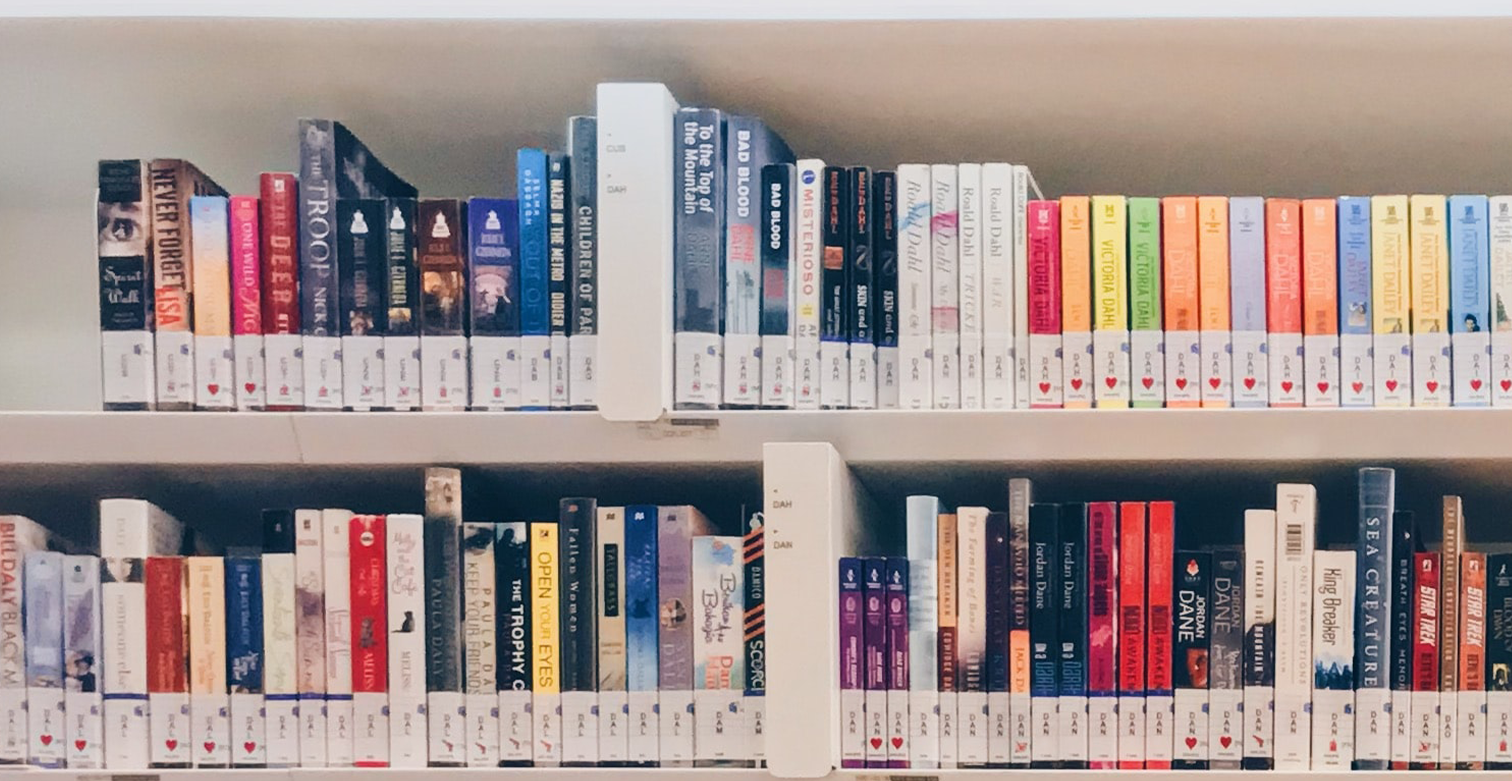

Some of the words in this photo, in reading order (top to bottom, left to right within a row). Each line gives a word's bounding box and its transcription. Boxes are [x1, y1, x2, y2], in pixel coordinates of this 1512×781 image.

[684, 122, 698, 146] the
[700, 125, 714, 140] To
[738, 131, 750, 162] BAD
[700, 143, 714, 167] the
[153, 169, 175, 222] NEVER
[684, 149, 698, 214] Mountain
[697, 171, 713, 195] Top
[738, 167, 750, 217] BLOOD
[770, 183, 780, 207] BAD
[700, 198, 714, 212] of
[964, 188, 974, 222] Roald
[990, 188, 1002, 222] Roald
[307, 180, 330, 278] TROOP
[551, 227, 564, 244] THE
[578, 206, 592, 278] CHILDREN
[770, 211, 780, 249] BLOOD
[803, 189, 814, 295] MISTERIOSO
[964, 226, 974, 256] Dahl
[990, 226, 1002, 256] Dahl
[157, 229, 186, 290] FORGET
[552, 248, 564, 281] METRO
[908, 232, 923, 272] Dahl
[936, 232, 951, 272] Dahl
[1102, 240, 1114, 293] VICTORIA
[1383, 232, 1396, 268] JANET
[1420, 232, 1434, 268] JANET
[1136, 243, 1150, 296] VICTORIA
[1274, 253, 1288, 299] DAHL
[156, 287, 180, 325] LISA
[552, 292, 564, 326] DIDIER
[579, 284, 592, 301] OF
[857, 285, 867, 306] SKIN
[884, 290, 894, 312] SKIN
[1384, 272, 1397, 314] DAILEY
[1421, 271, 1434, 314] DAILEY
[1102, 299, 1115, 328] DAHL
[1137, 300, 1151, 329] DAHL
[773, 500, 792, 509] DAH
[0, 523, 15, 558] BILL
[568, 528, 580, 574] Fallen
[774, 540, 792, 549] DAN
[1366, 518, 1379, 556] SEA
[538, 552, 552, 598] OPEN
[966, 534, 978, 584] Farming
[1035, 542, 1047, 578] Jordan
[1062, 542, 1074, 578] Jordan
[0, 559, 16, 604] DALY
[466, 562, 479, 595] KEEP
[512, 580, 522, 600] THE
[751, 566, 762, 599] DAMICO
[1036, 582, 1047, 609] Dane
[1063, 581, 1074, 608] Dane
[1318, 568, 1342, 594] King
[1400, 560, 1408, 604] BREATH
[431, 578, 443, 630] PAULA
[467, 600, 480, 637] YOUR
[482, 588, 492, 649] PAULA
[569, 581, 580, 632] Women
[1178, 590, 1194, 642] DANE
[1196, 595, 1205, 638] JORDAN
[1214, 578, 1230, 634] DANE
[1232, 584, 1240, 628] JORDAN
[1420, 586, 1436, 616] STAR
[1466, 586, 1482, 616] STAR
[2, 612, 18, 663] BLACK
[511, 604, 525, 674] TROPHY
[540, 604, 552, 640] YOUR
[1322, 598, 1342, 646] Breaker
[1364, 568, 1378, 686] CREATURE
[1400, 612, 1408, 640] EYES
[1420, 618, 1436, 646] TREK
[1466, 618, 1483, 648] TREK
[432, 636, 444, 678] DALY
[538, 644, 554, 688] EYES
[1016, 648, 1026, 674] JACK
